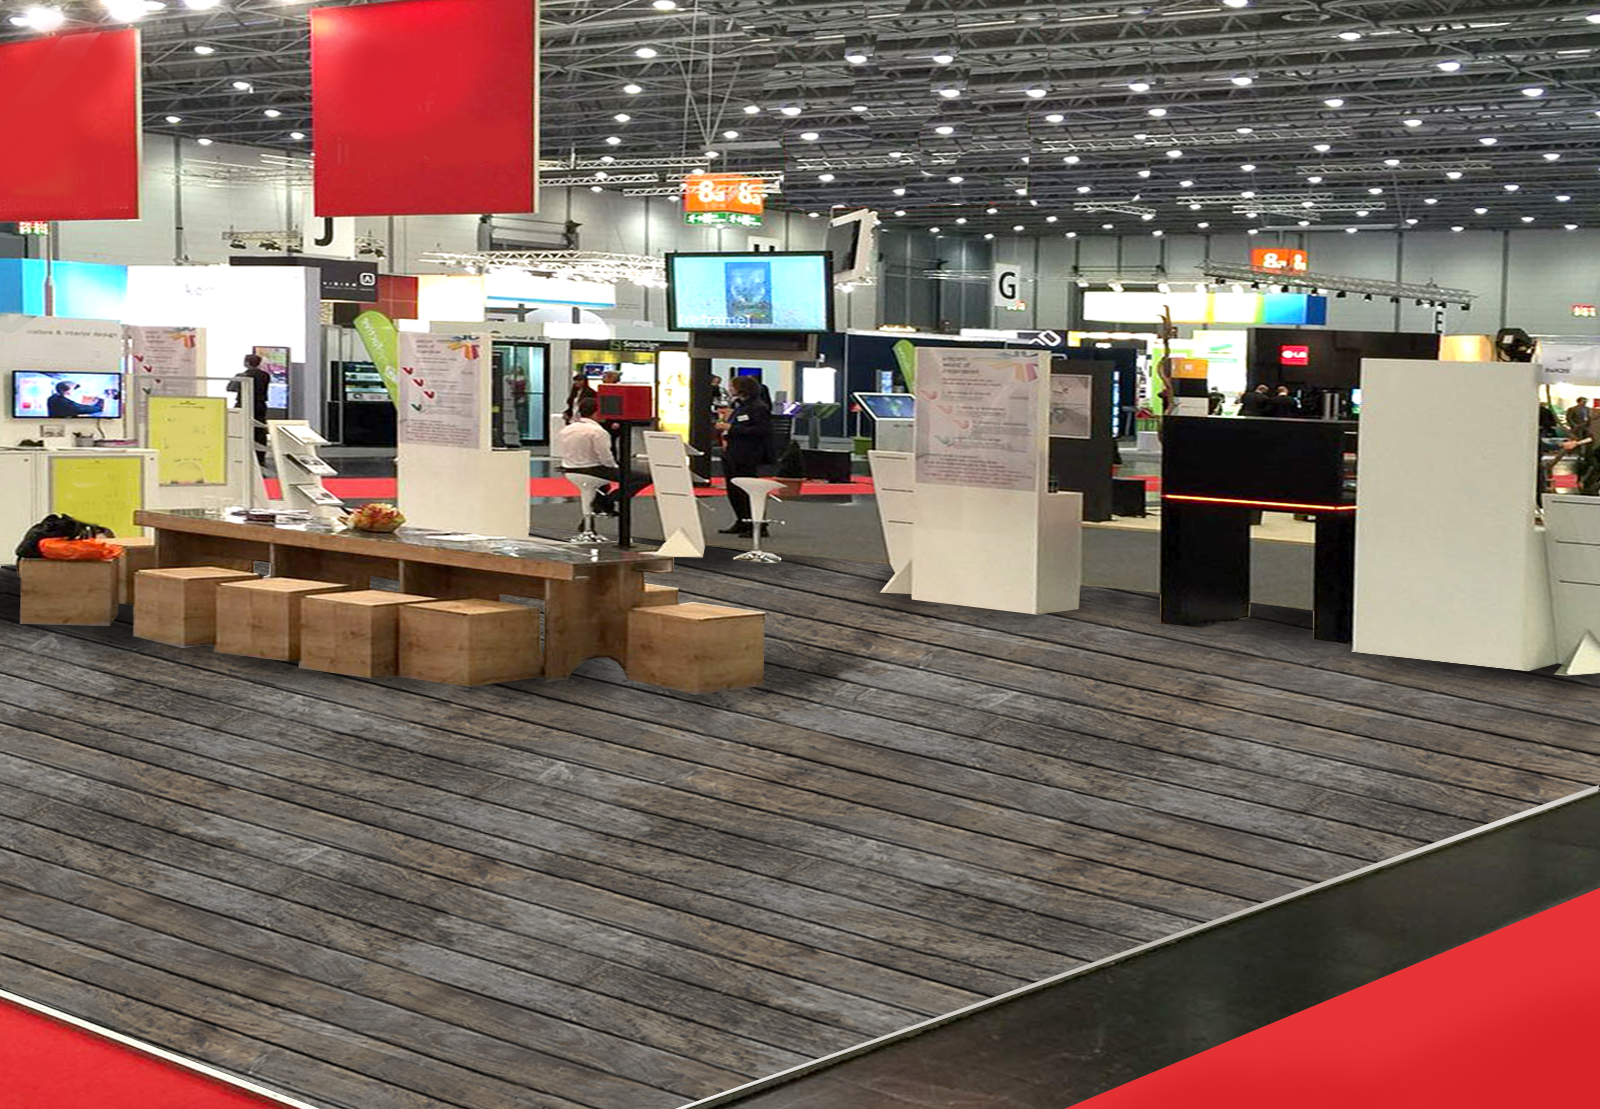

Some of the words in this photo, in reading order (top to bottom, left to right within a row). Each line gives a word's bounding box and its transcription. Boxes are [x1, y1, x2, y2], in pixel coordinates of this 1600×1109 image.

[314, 216, 334, 247] J
[998, 271, 1016, 300] G
[1435, 311, 1444, 334] E
